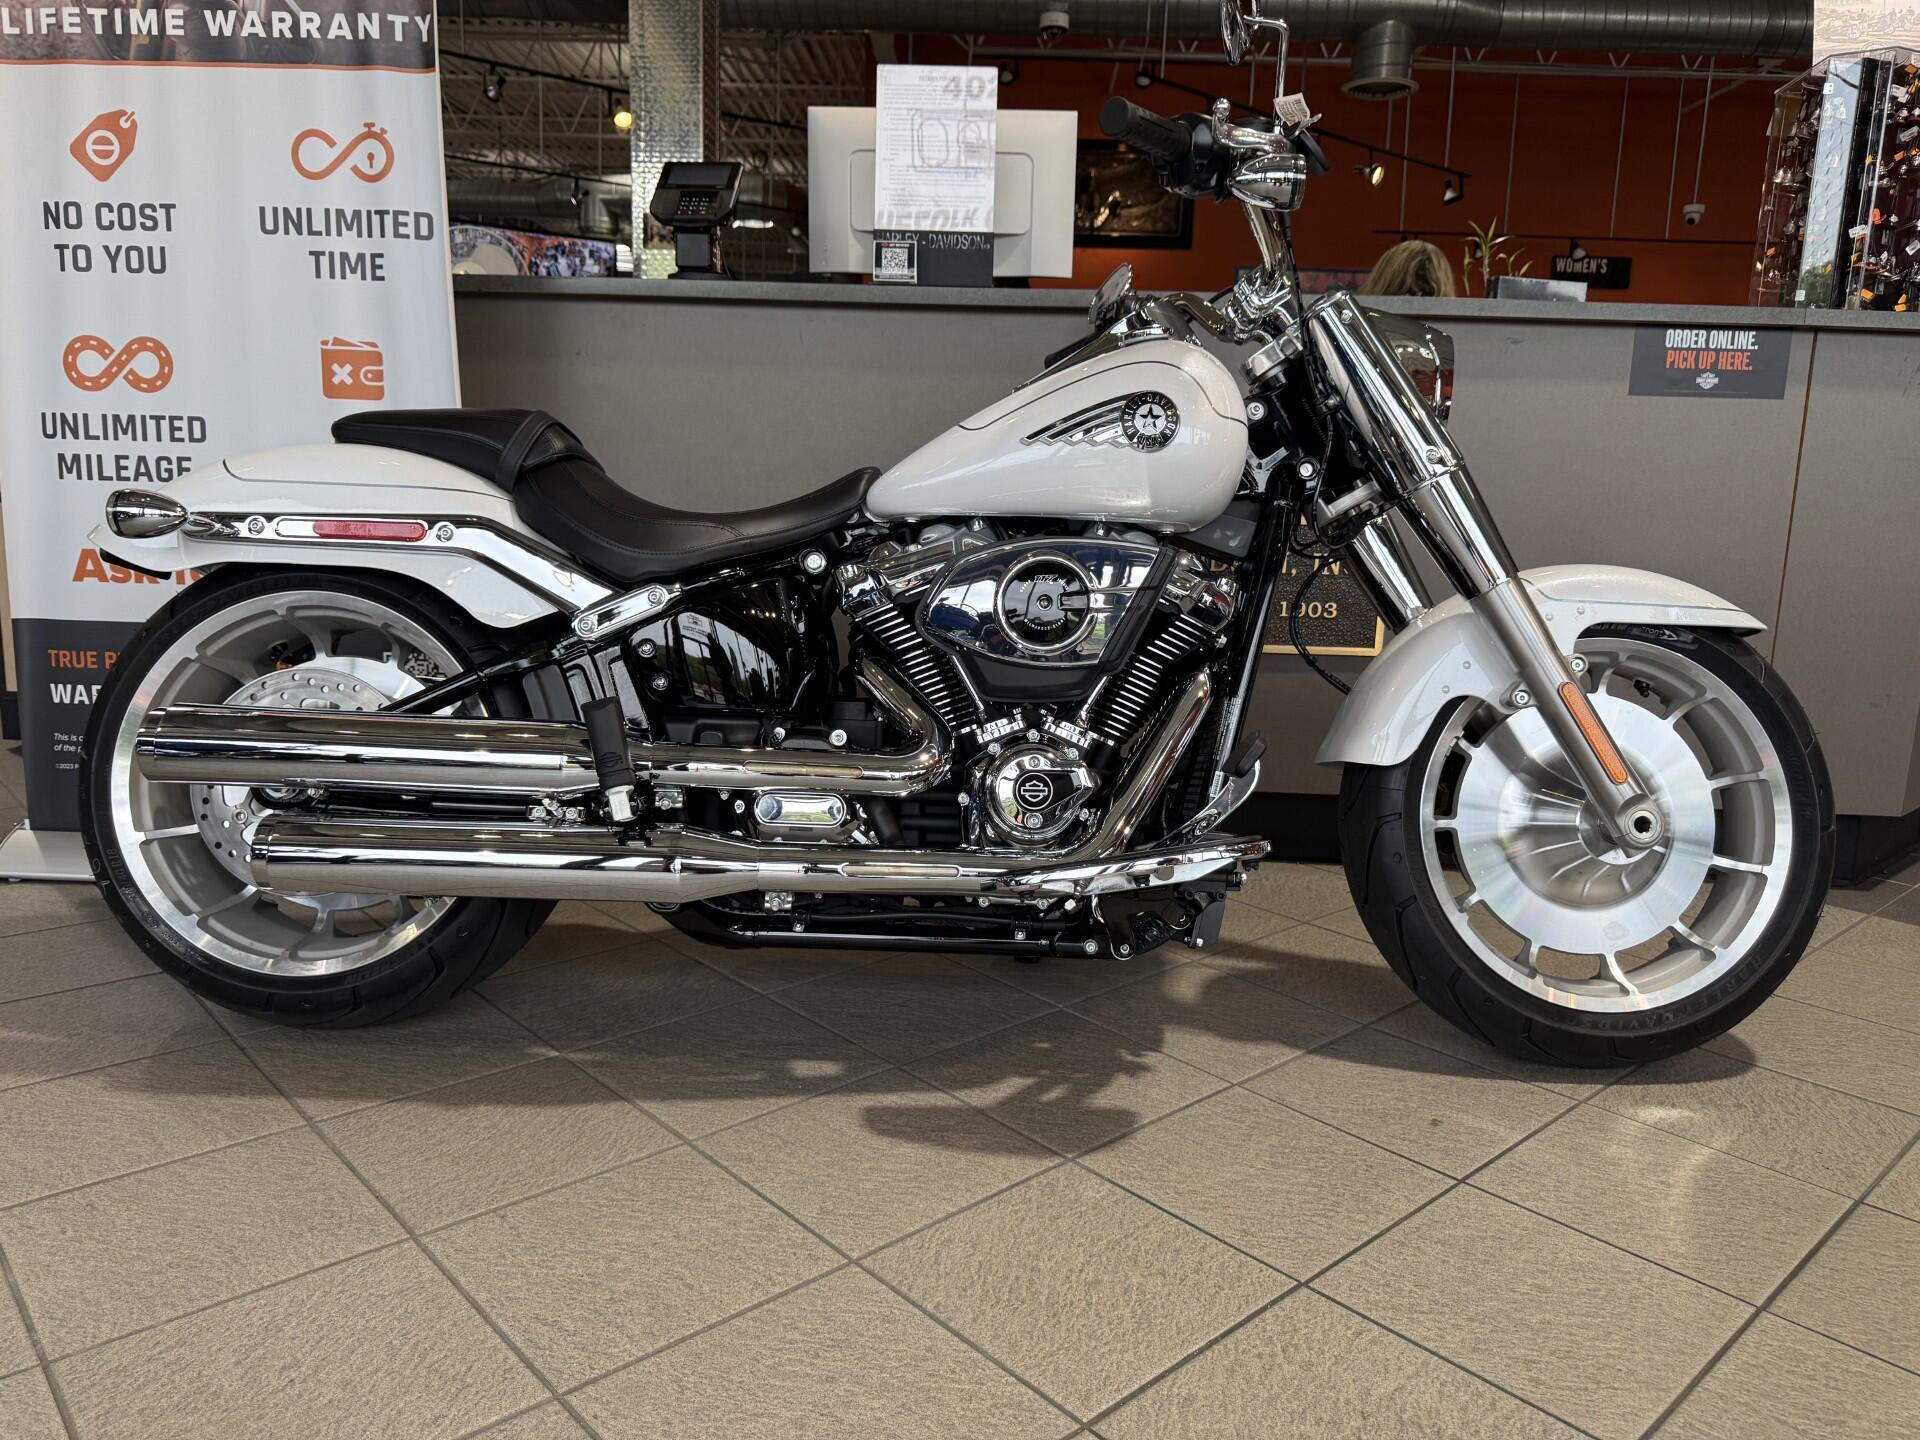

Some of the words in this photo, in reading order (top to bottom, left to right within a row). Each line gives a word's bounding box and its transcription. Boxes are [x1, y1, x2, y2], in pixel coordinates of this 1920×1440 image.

[1, 7, 185, 36] LIFETIME
[204, 10, 431, 43] WARRANTY
[43, 201, 83, 230] NO
[95, 202, 177, 232] COST
[259, 206, 434, 241] UNLIMITED
[54, 244, 92, 272] TO
[102, 245, 167, 274] YOU
[309, 250, 386, 281] TIME
[1665, 329, 1707, 348] ORDER
[1709, 330, 1758, 350] ONLINE.
[1666, 350, 1696, 368] PICK
[1699, 351, 1716, 369] UP
[1718, 352, 1752, 371] HERE.
[41, 412, 207, 443] UNLIMITED
[48, 650, 98, 668] TRUE
[54, 733, 69, 741] This
